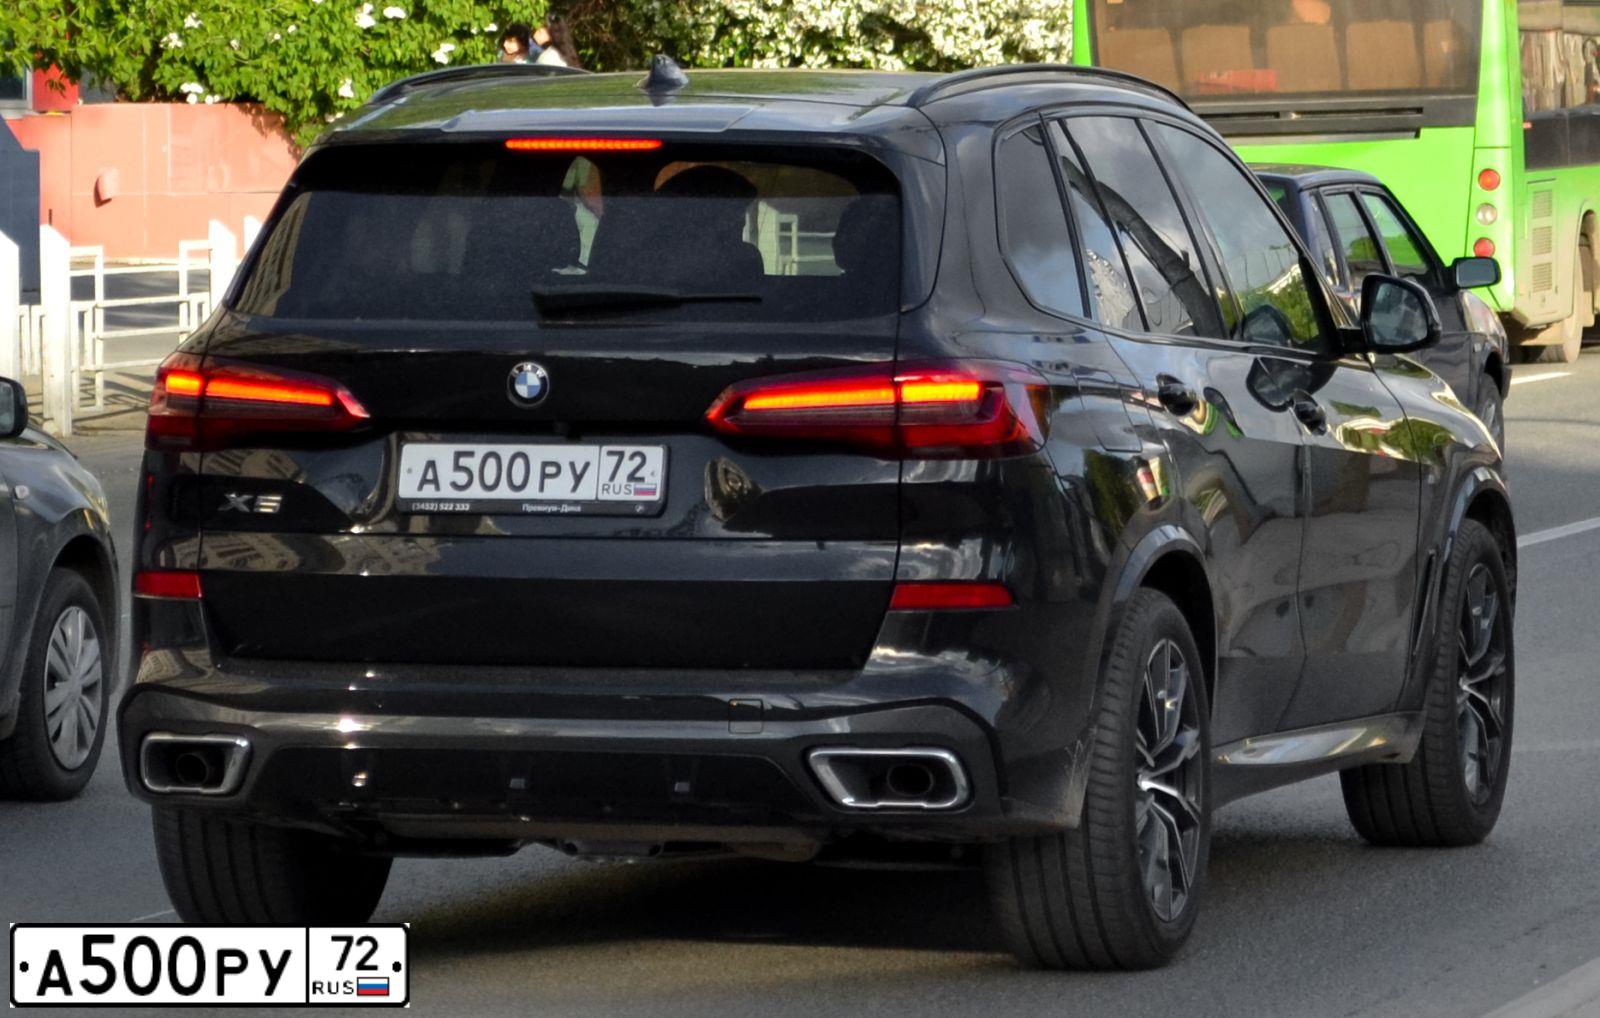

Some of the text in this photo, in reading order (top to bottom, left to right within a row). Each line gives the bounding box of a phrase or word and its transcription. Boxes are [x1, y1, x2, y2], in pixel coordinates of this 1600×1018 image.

[606, 450, 647, 483] 72
[601, 483, 632, 495] RUS
[218, 493, 282, 513] X5
